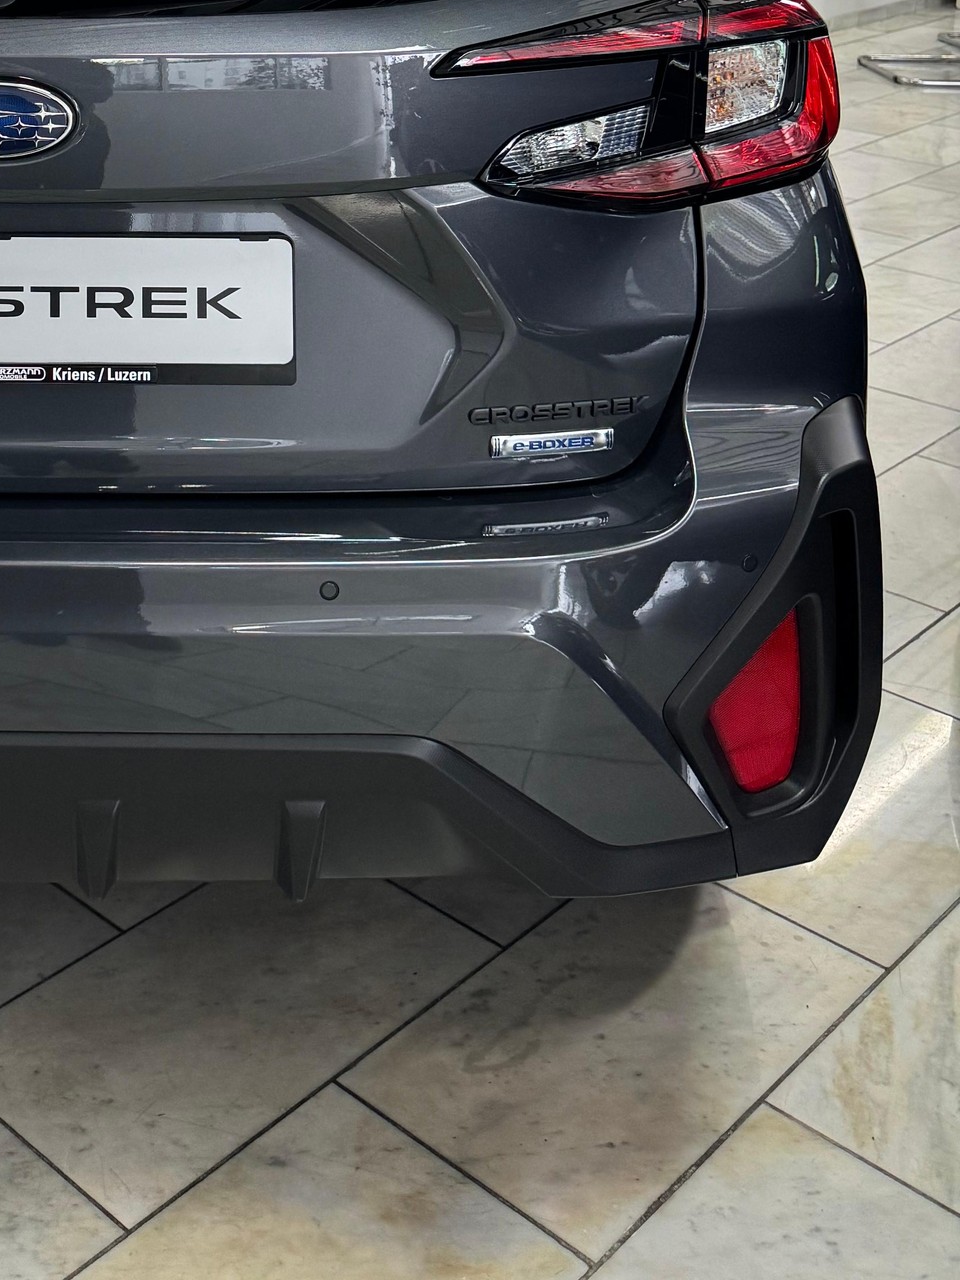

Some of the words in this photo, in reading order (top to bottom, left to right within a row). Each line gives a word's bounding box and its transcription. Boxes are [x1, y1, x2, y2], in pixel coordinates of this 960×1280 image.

[52, 367, 96, 381] Kriens
[97, 367, 105, 383] /
[107, 367, 151, 381] Luzern
[467, 395, 650, 426] CROSSTREK
[512, 436, 595, 452] e-BOXER
